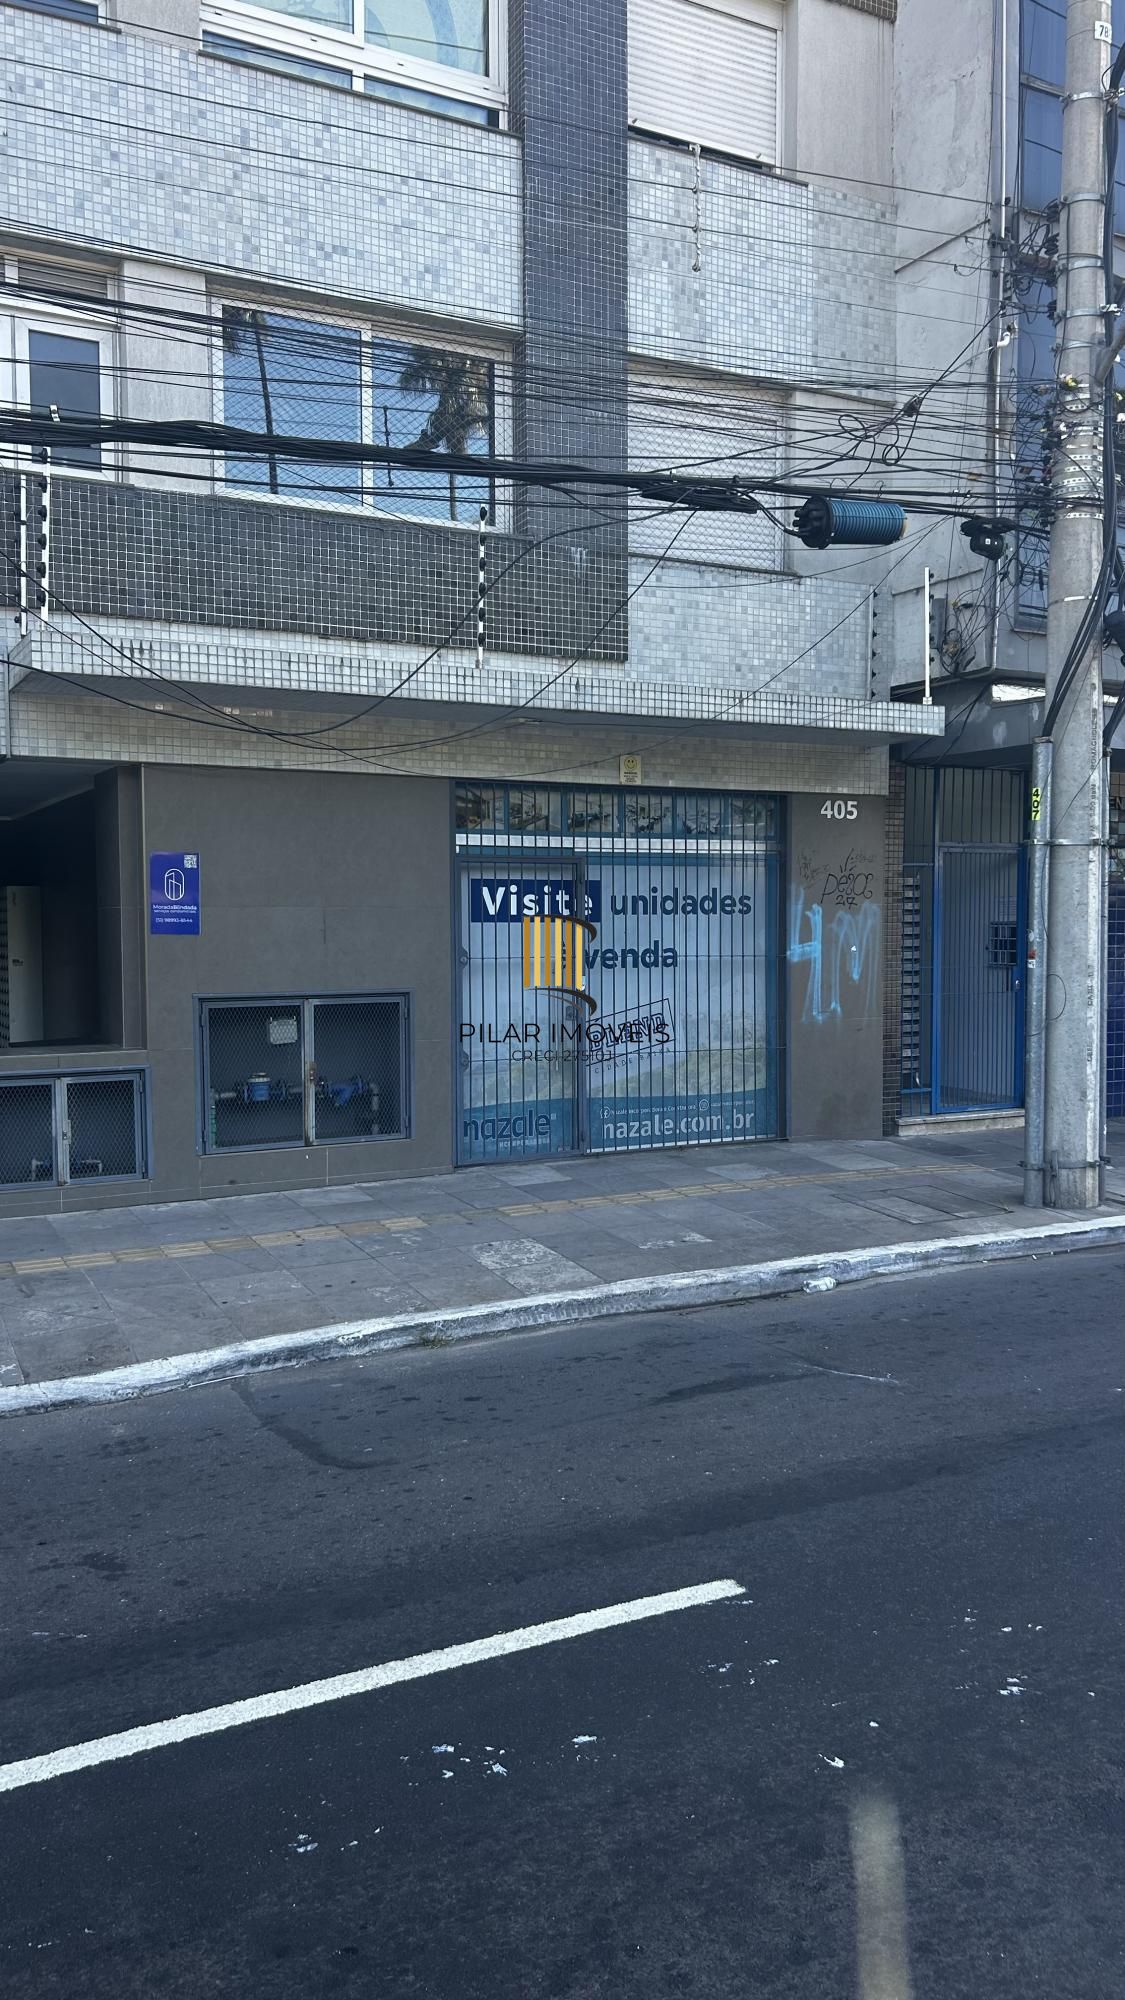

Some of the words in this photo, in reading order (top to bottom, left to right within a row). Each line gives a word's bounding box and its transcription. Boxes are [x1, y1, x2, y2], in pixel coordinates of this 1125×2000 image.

[820, 799, 858, 820] 405
[1032, 788, 1040, 820] 407
[610, 886, 752, 916] unidades
[584, 939, 678, 970] venda
[603, 1109, 755, 1139] nazale.com.br
